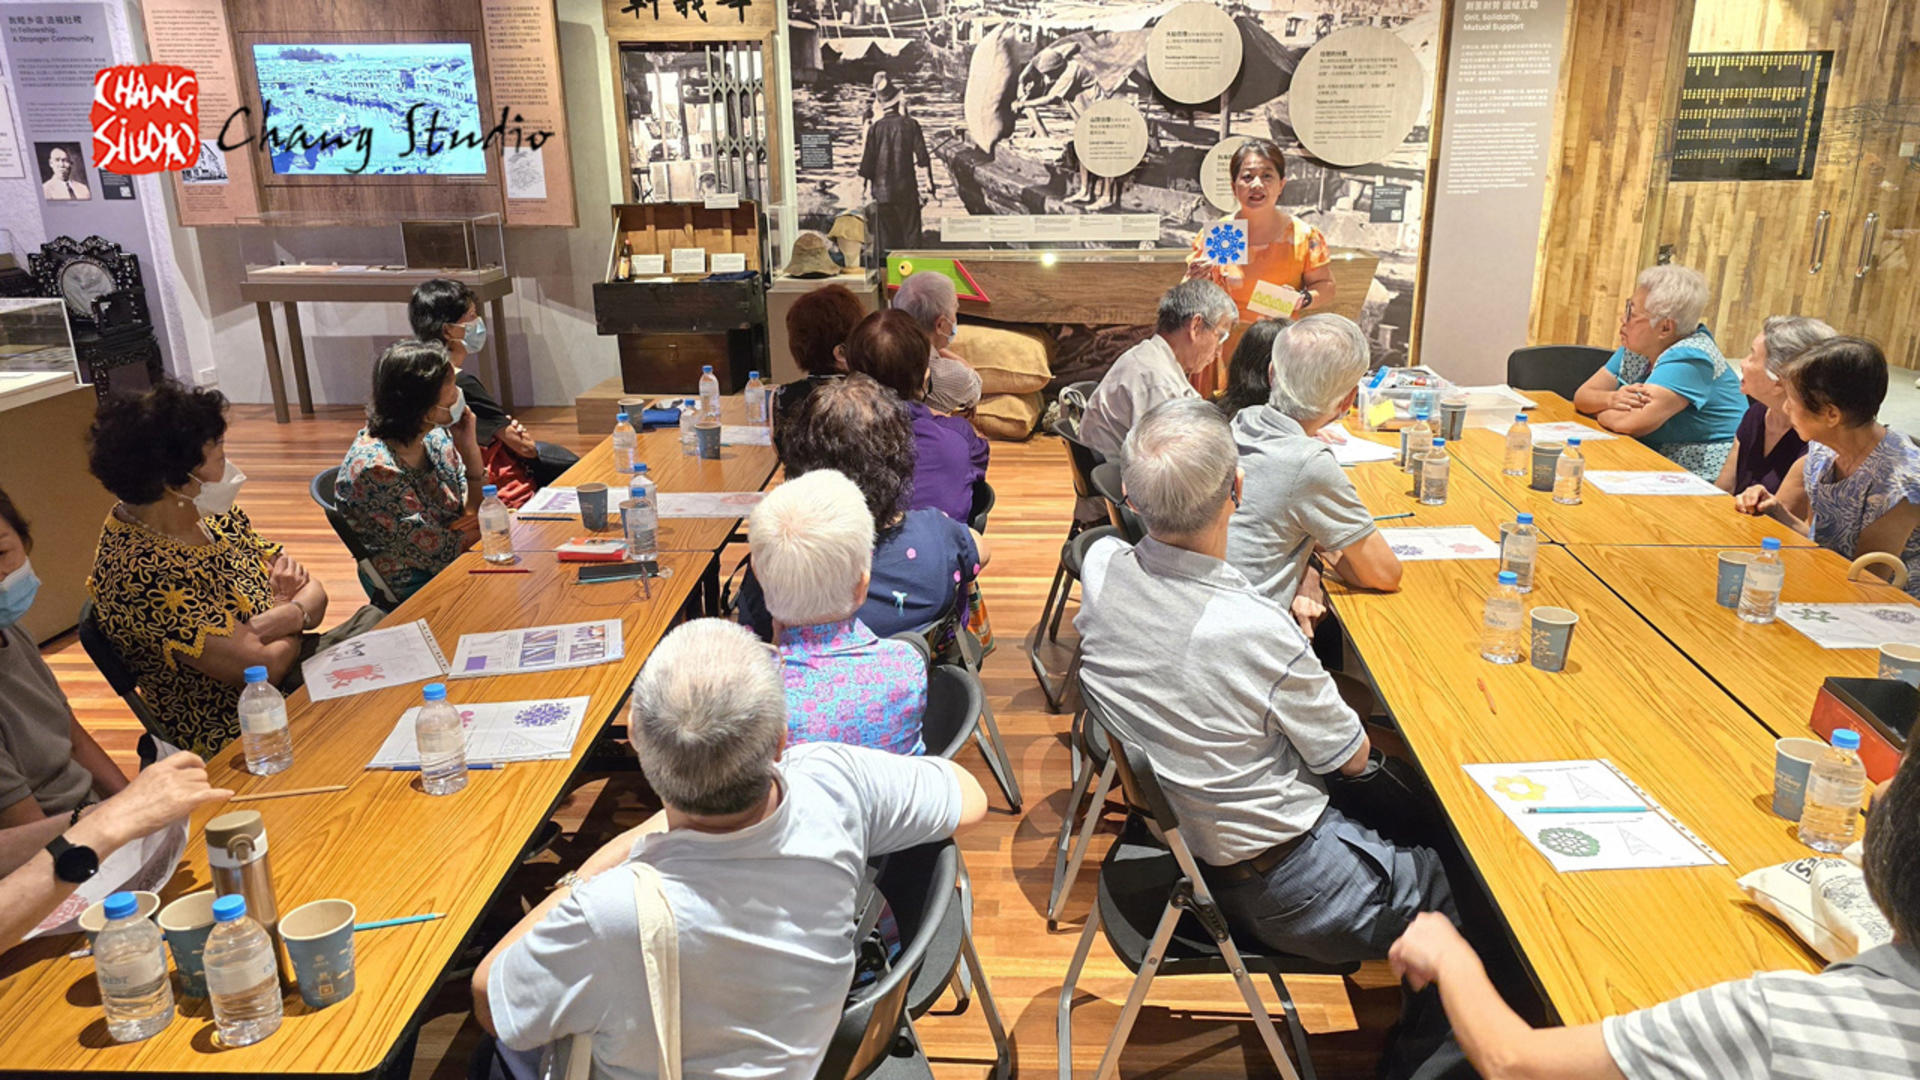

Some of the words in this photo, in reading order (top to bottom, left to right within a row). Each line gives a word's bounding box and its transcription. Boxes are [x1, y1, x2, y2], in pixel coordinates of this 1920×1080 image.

[1463, 23, 1491, 31] Mutual
[1492, 23, 1524, 32] Support
[50, 35, 94, 43] Community
